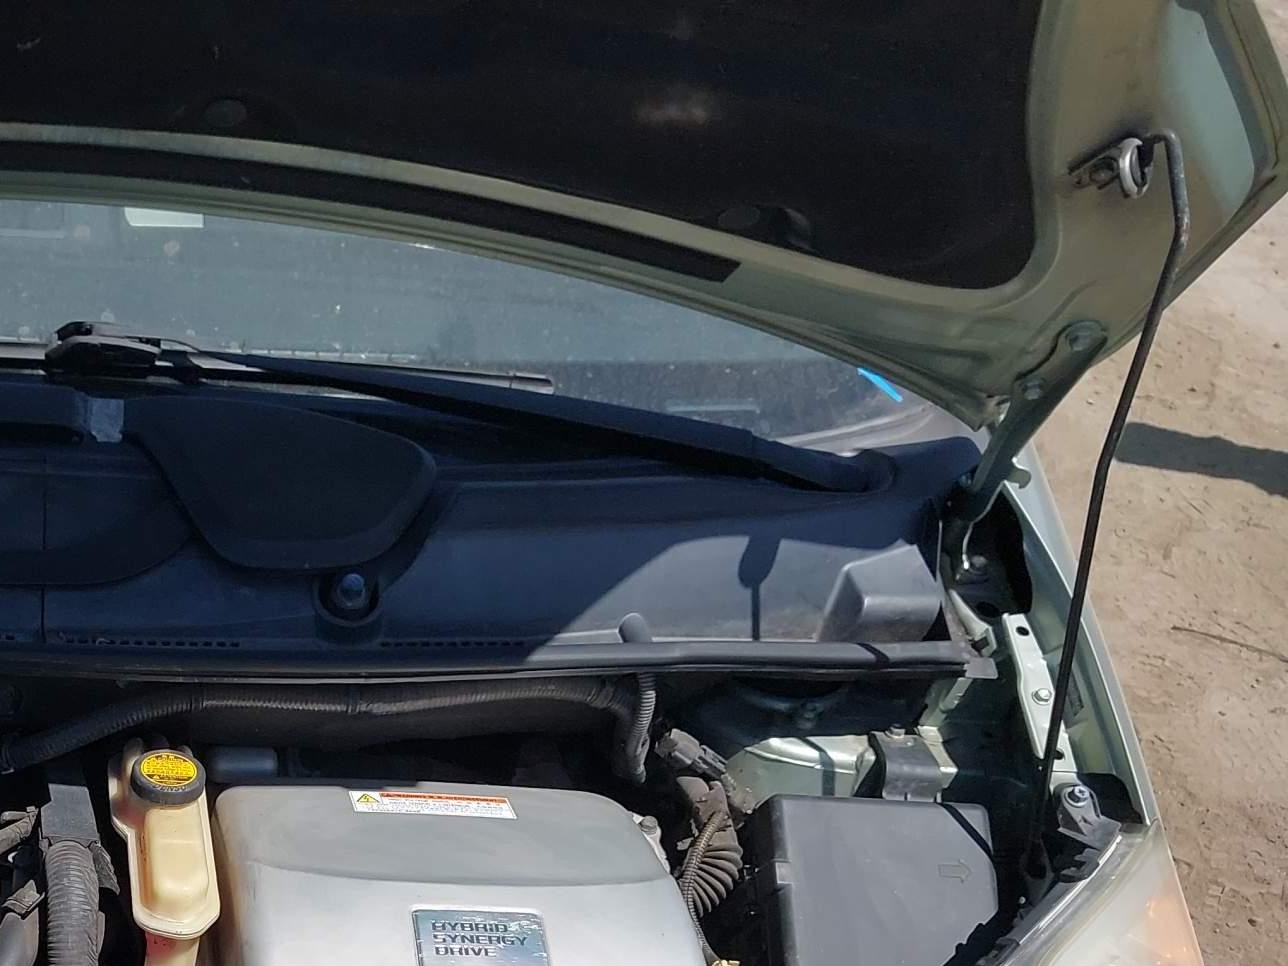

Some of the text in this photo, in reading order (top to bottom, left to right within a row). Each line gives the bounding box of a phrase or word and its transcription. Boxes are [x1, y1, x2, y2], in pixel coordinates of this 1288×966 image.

[431, 922, 509, 933] HYBRID
[432, 934, 528, 946] SYNERGY
[434, 946, 497, 957] DRIVE
